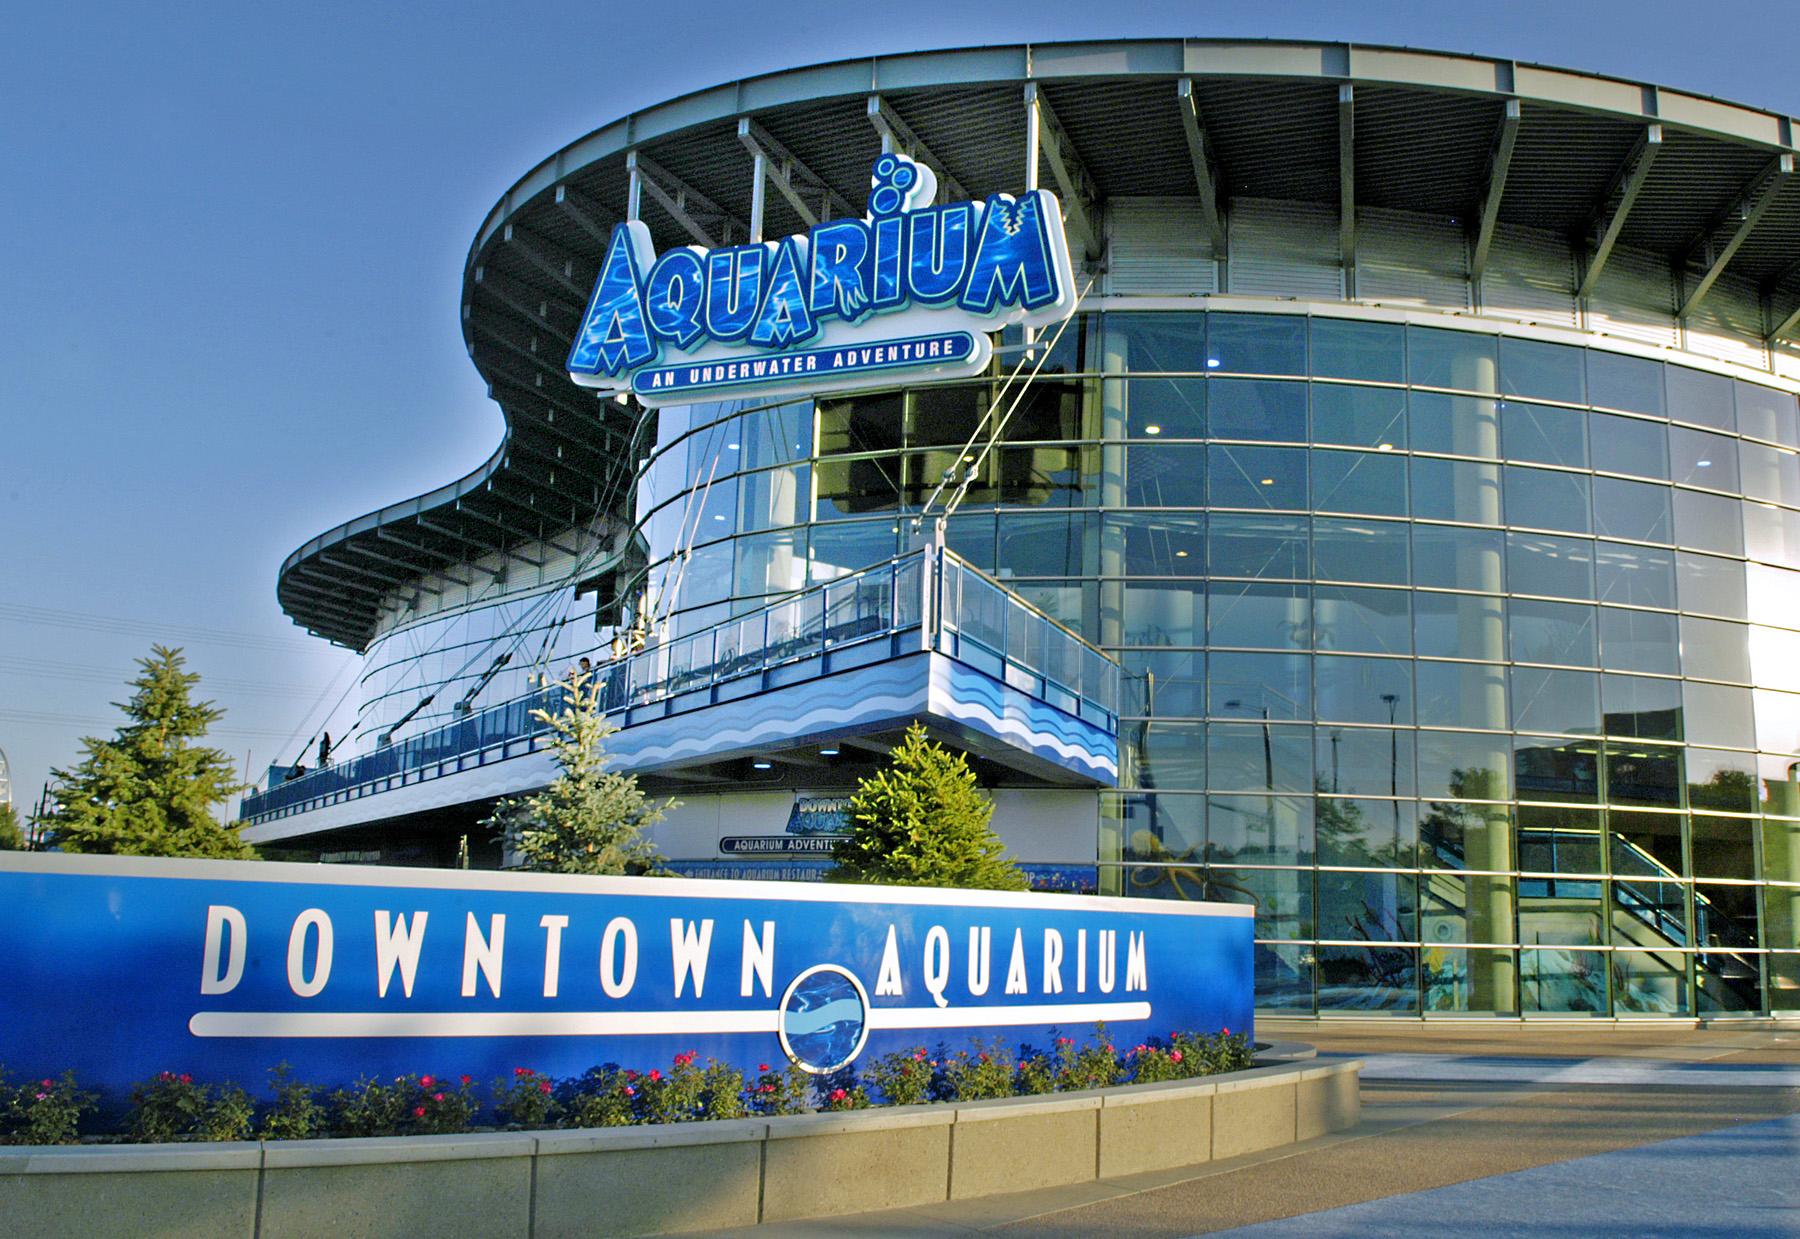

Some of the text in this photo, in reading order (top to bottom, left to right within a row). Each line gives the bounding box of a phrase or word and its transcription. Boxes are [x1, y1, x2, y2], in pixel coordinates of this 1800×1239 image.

[652, 339, 953, 388] AN UNDERWATER ADVENTURE
[734, 840, 783, 851] AQUARIUM
[741, 869, 779, 880] AQUARIUM
[201, 904, 1148, 1008] DOWNTOWN AQUARIUM
